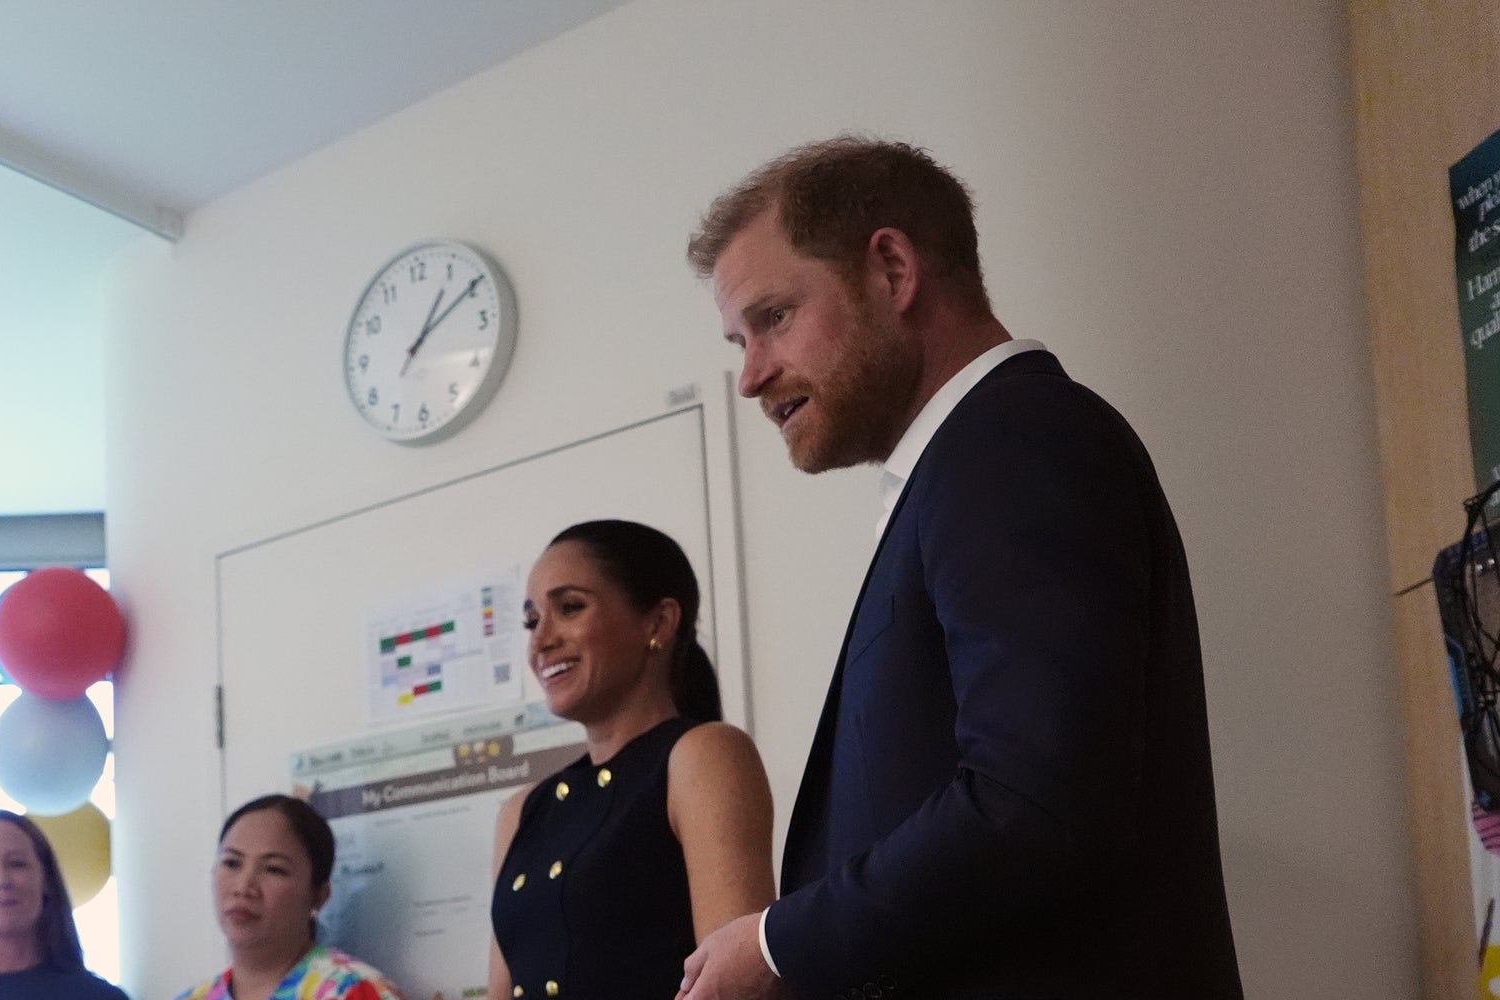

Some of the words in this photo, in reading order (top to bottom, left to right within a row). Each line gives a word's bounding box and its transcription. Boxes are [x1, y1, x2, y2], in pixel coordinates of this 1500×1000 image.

[410, 262, 427, 284] 12
[446, 263, 453, 282] 1
[383, 284, 398, 305] 11
[366, 315, 383, 336] 10
[478, 309, 489, 331] 3
[358, 354, 371, 375] 9
[367, 386, 379, 407] 8
[449, 382, 459, 403] 5
[391, 402, 401, 423] 7
[418, 402, 430, 424] 6
[383, 771, 486, 802] Communication
[487, 759, 531, 783] Board
